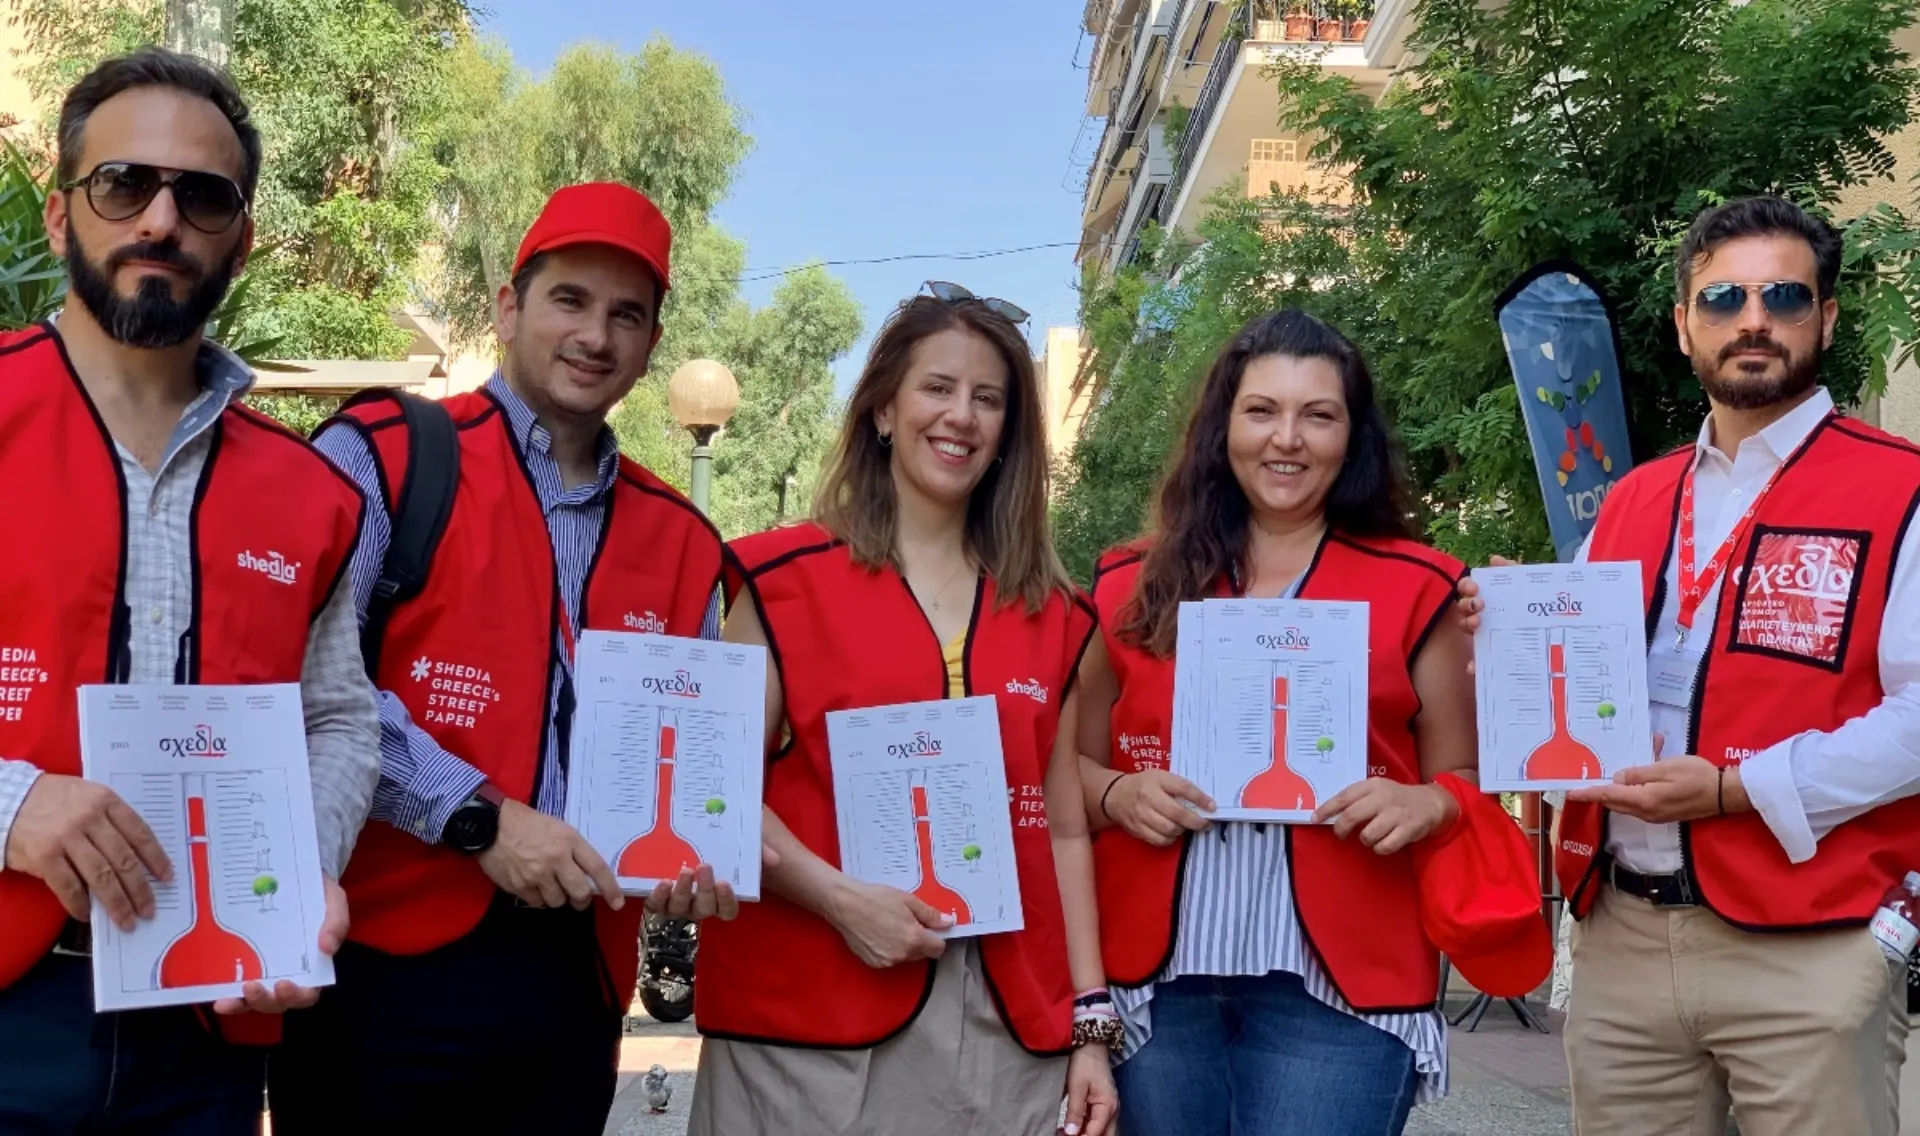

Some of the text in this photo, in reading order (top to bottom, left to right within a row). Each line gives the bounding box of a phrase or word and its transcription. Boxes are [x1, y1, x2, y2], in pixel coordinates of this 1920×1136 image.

[434, 661, 491, 684] SHEDIA
[431, 678, 500, 702] GREECE's
[428, 693, 487, 714] STREET
[425, 709, 476, 729] PAPER
